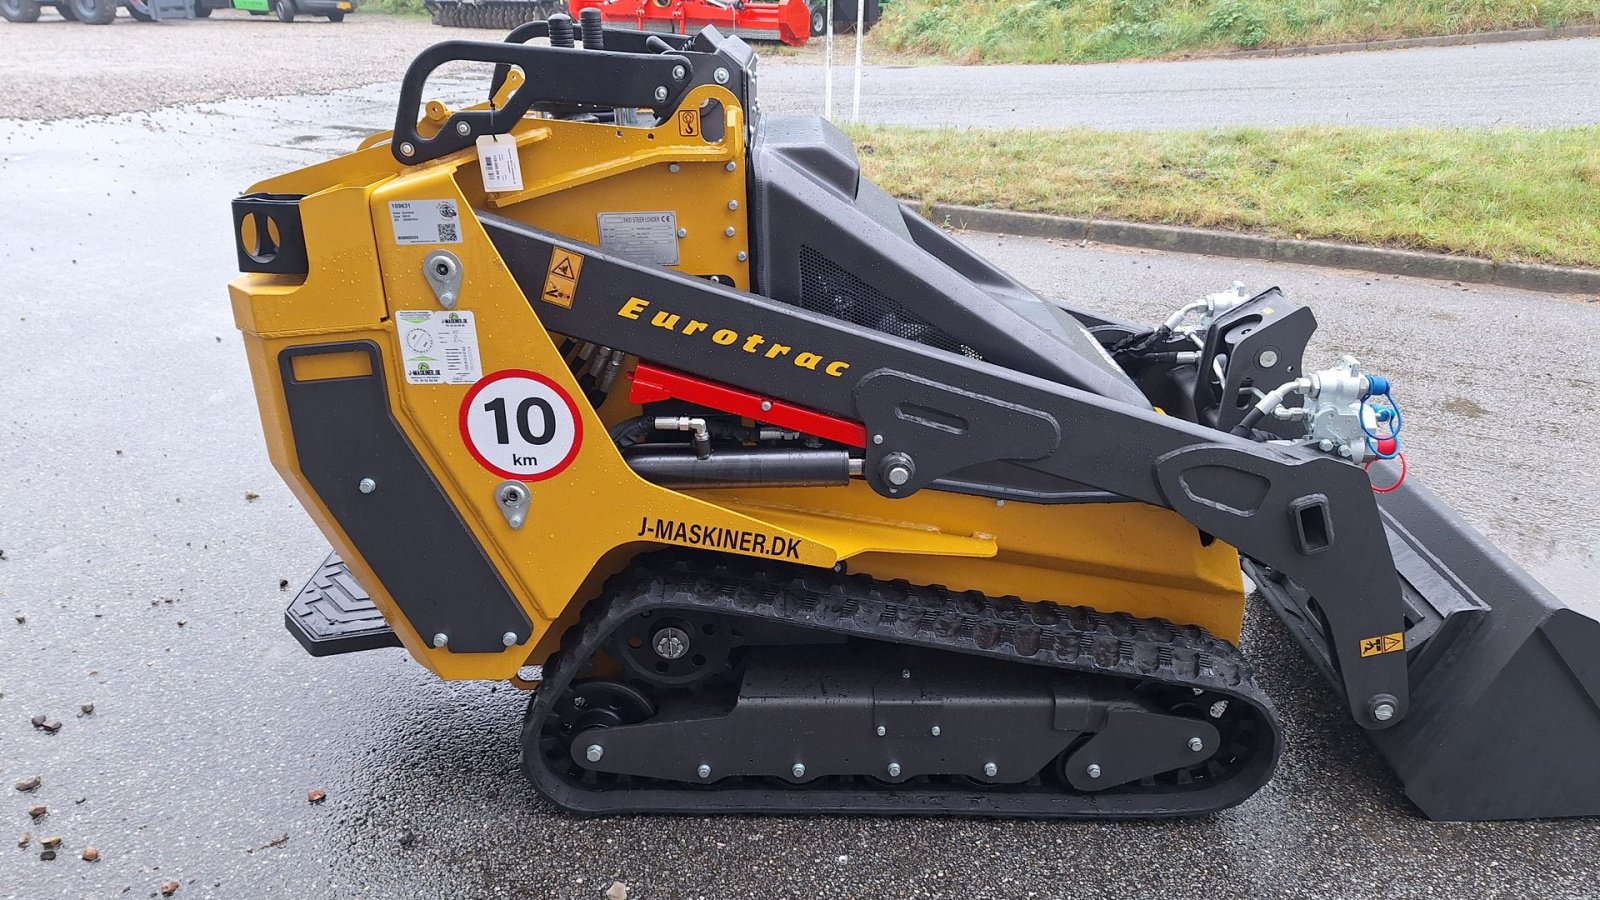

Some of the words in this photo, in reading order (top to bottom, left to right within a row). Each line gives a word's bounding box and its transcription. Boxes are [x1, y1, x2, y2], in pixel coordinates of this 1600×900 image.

[617, 296, 851, 378] Eurotrac
[484, 396, 556, 445] 10
[512, 453, 538, 466] km
[637, 516, 802, 559] J-MASKINER.DK
